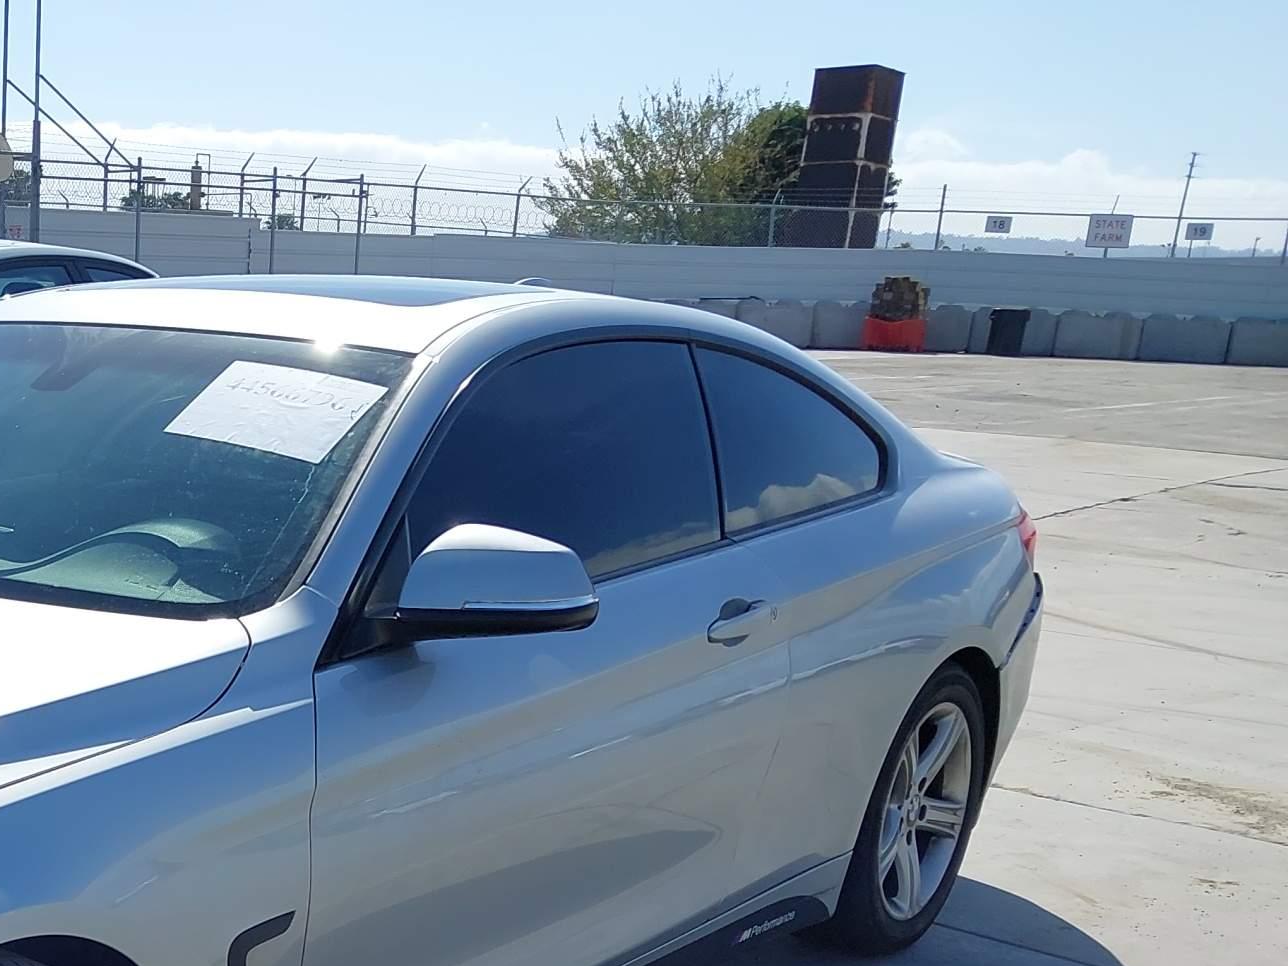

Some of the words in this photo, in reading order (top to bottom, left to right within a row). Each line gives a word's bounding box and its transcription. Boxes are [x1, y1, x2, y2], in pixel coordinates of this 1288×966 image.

[992, 219, 1006, 230] 18
[1095, 219, 1127, 230] STATE
[1094, 232, 1123, 242] FARM
[1193, 226, 1207, 237] 19
